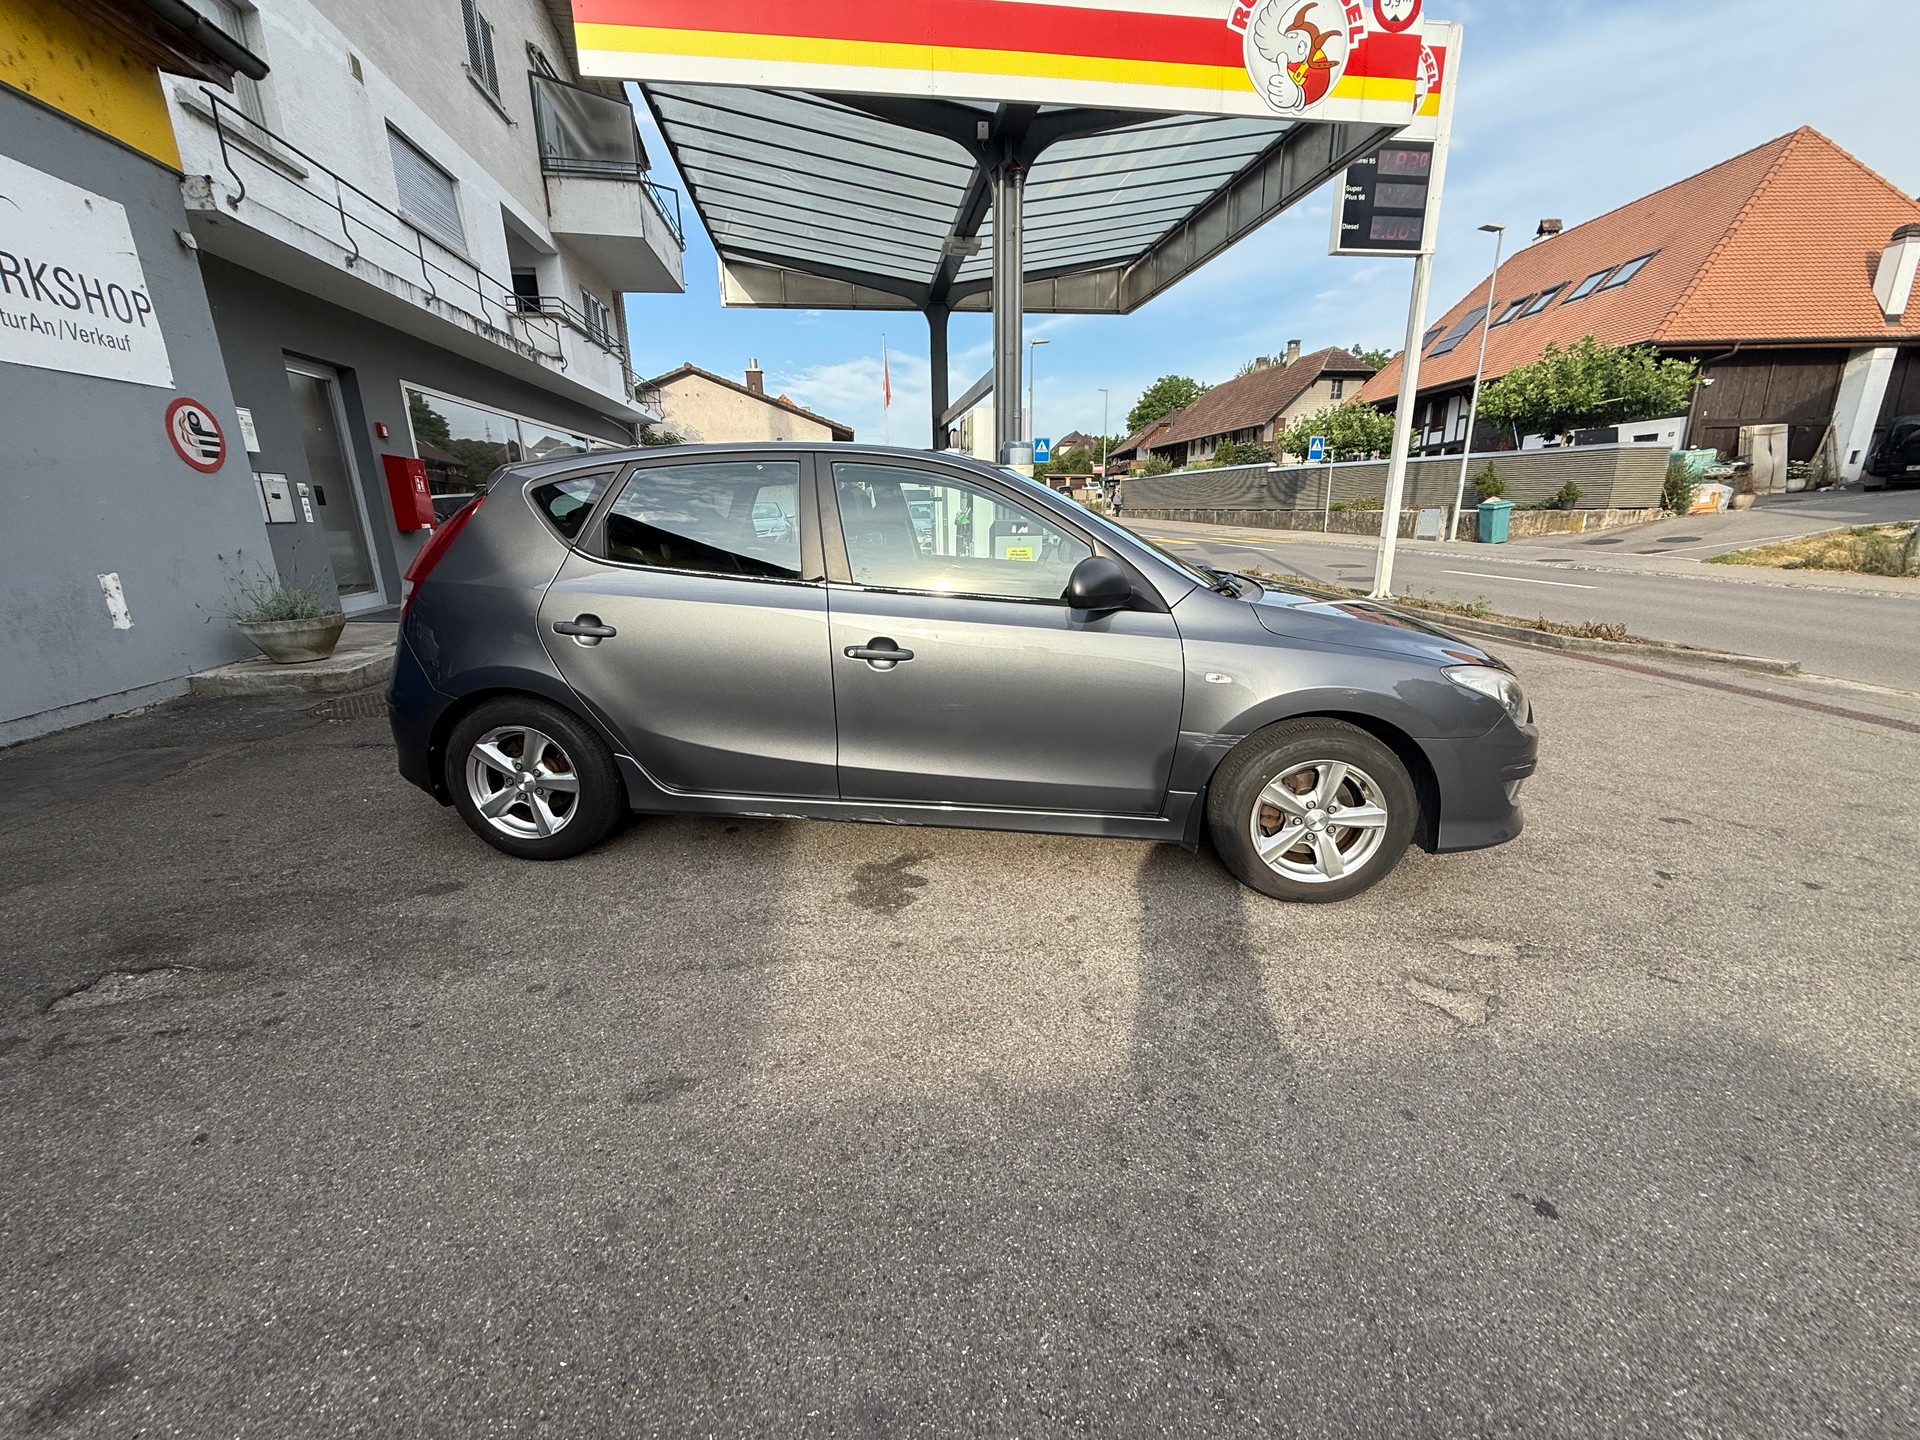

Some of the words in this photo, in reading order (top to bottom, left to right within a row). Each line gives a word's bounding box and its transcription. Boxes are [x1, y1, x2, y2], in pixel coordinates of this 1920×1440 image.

[1345, 184, 1363, 193] Super
[1344, 193, 1357, 201] Plus
[0, 251, 152, 328] RKSHOP
